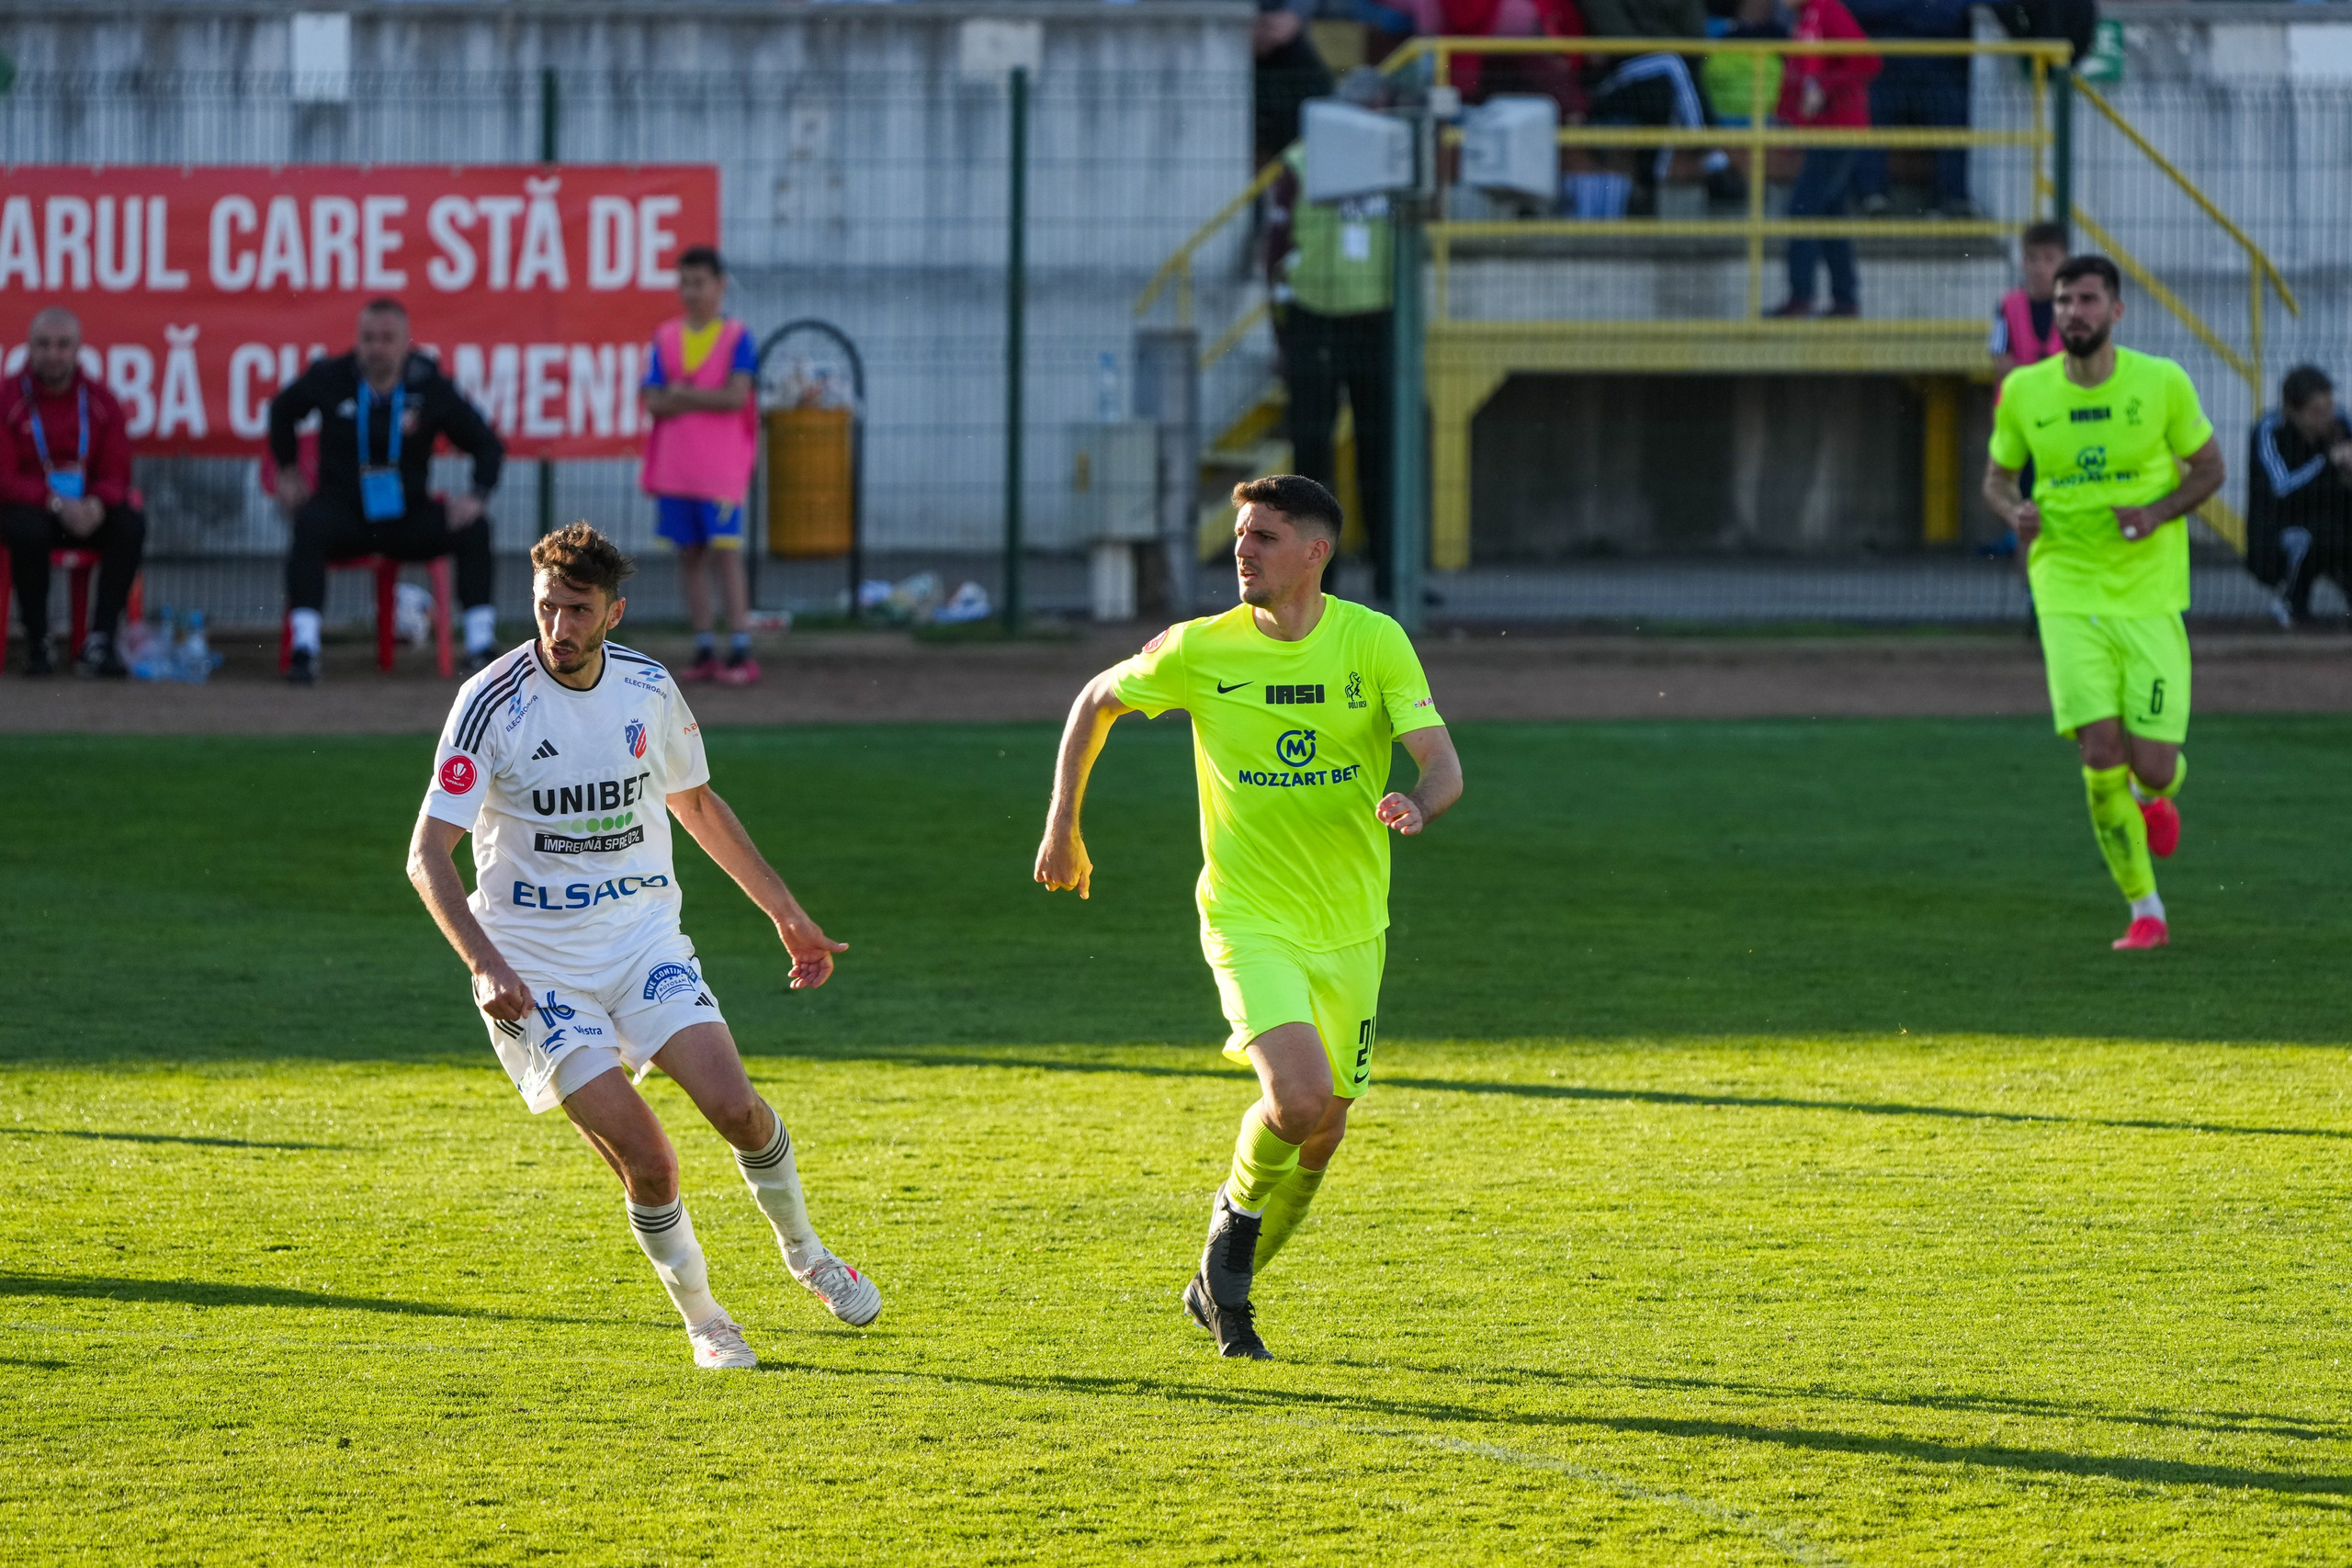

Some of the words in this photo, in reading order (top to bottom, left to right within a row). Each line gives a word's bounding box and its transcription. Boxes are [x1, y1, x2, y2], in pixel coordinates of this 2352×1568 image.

[209, 195, 407, 291] CARE
[426, 177, 568, 291] STĂ
[587, 195, 682, 291] DE
[1265, 684, 1325, 705] IASI
[2151, 678, 2165, 715] 6
[1238, 770, 1327, 787] MOZZART
[1331, 764, 1360, 784] BET
[533, 772, 650, 817] UNIBET
[513, 874, 669, 910] ELSACO
[646, 980, 657, 997] FIVE
[533, 990, 576, 1030] 16
